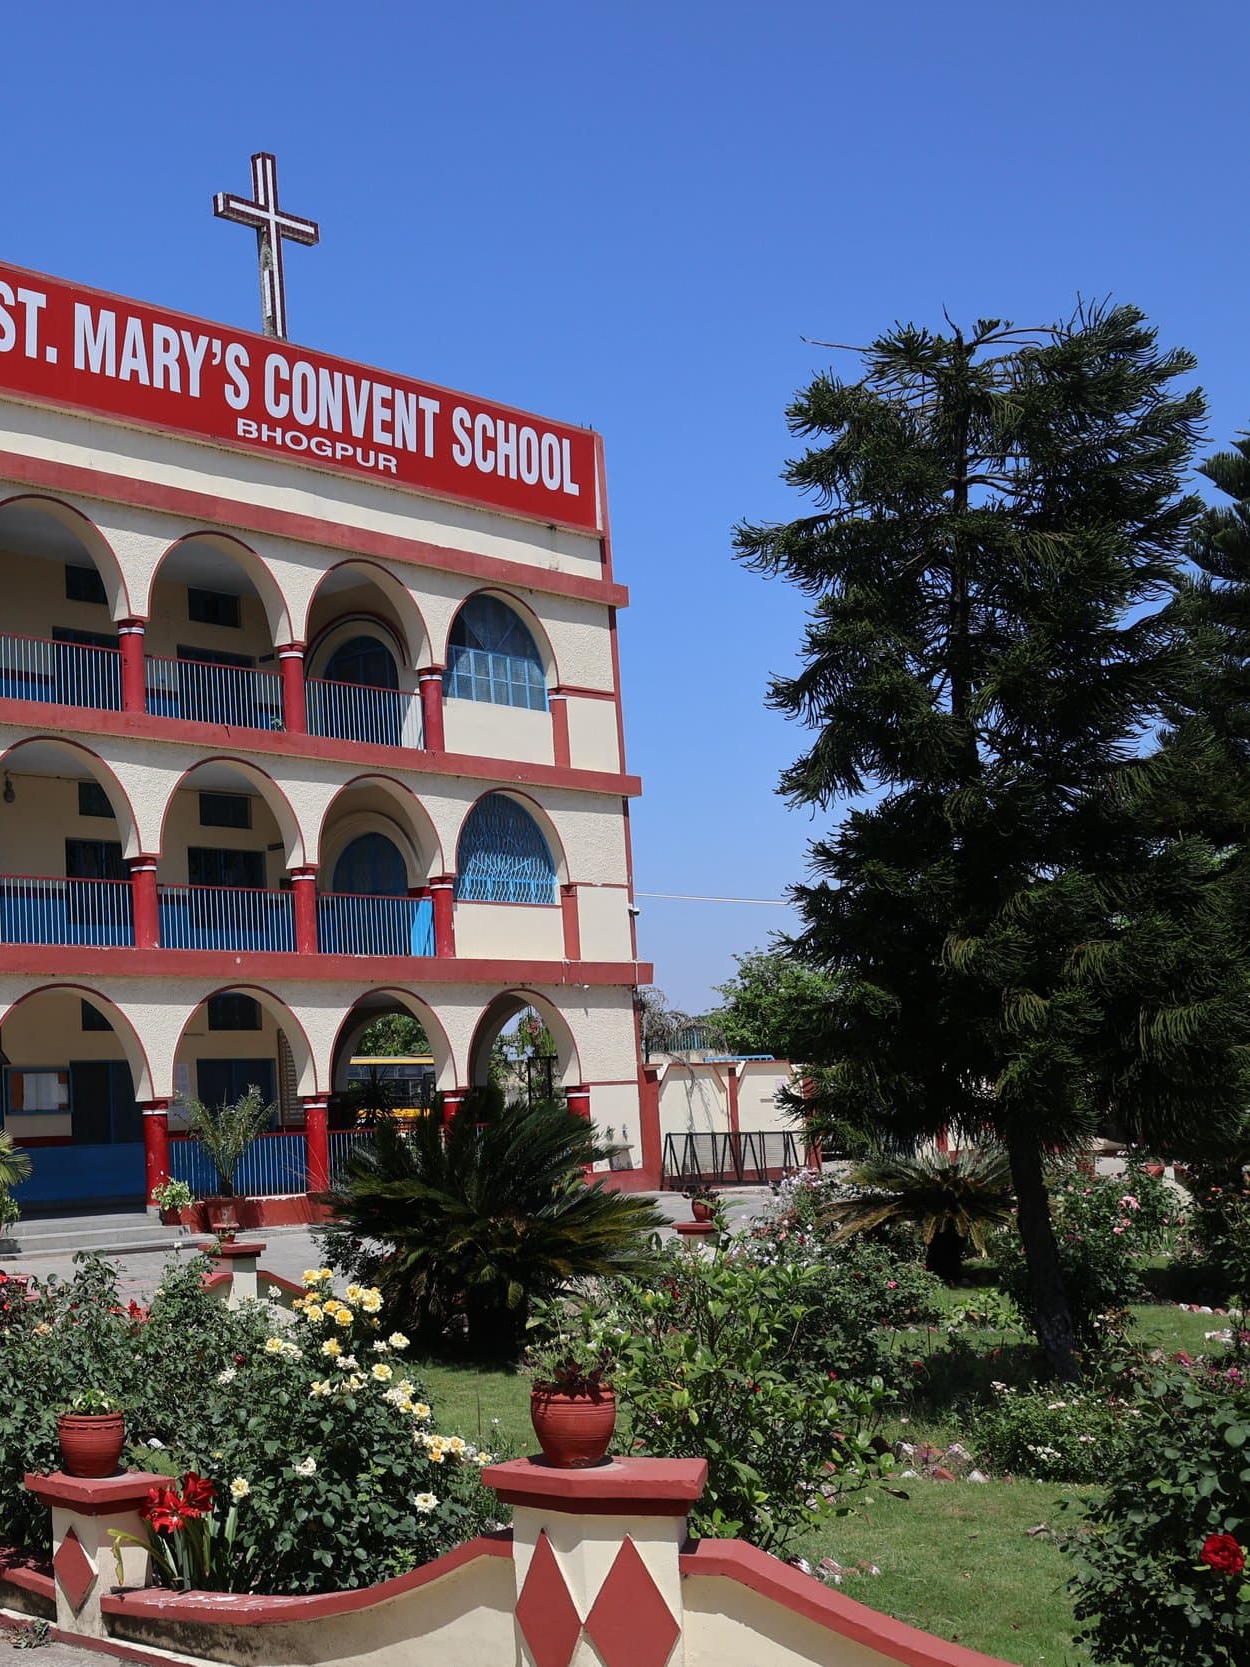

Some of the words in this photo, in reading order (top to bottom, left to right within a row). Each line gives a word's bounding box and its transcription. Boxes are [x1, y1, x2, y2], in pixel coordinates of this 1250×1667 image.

[73, 301, 251, 412] MARY'S
[264, 353, 441, 460] CONVENT
[452, 406, 581, 497] SCHOOL
[236, 417, 398, 474] BHOGPUR
